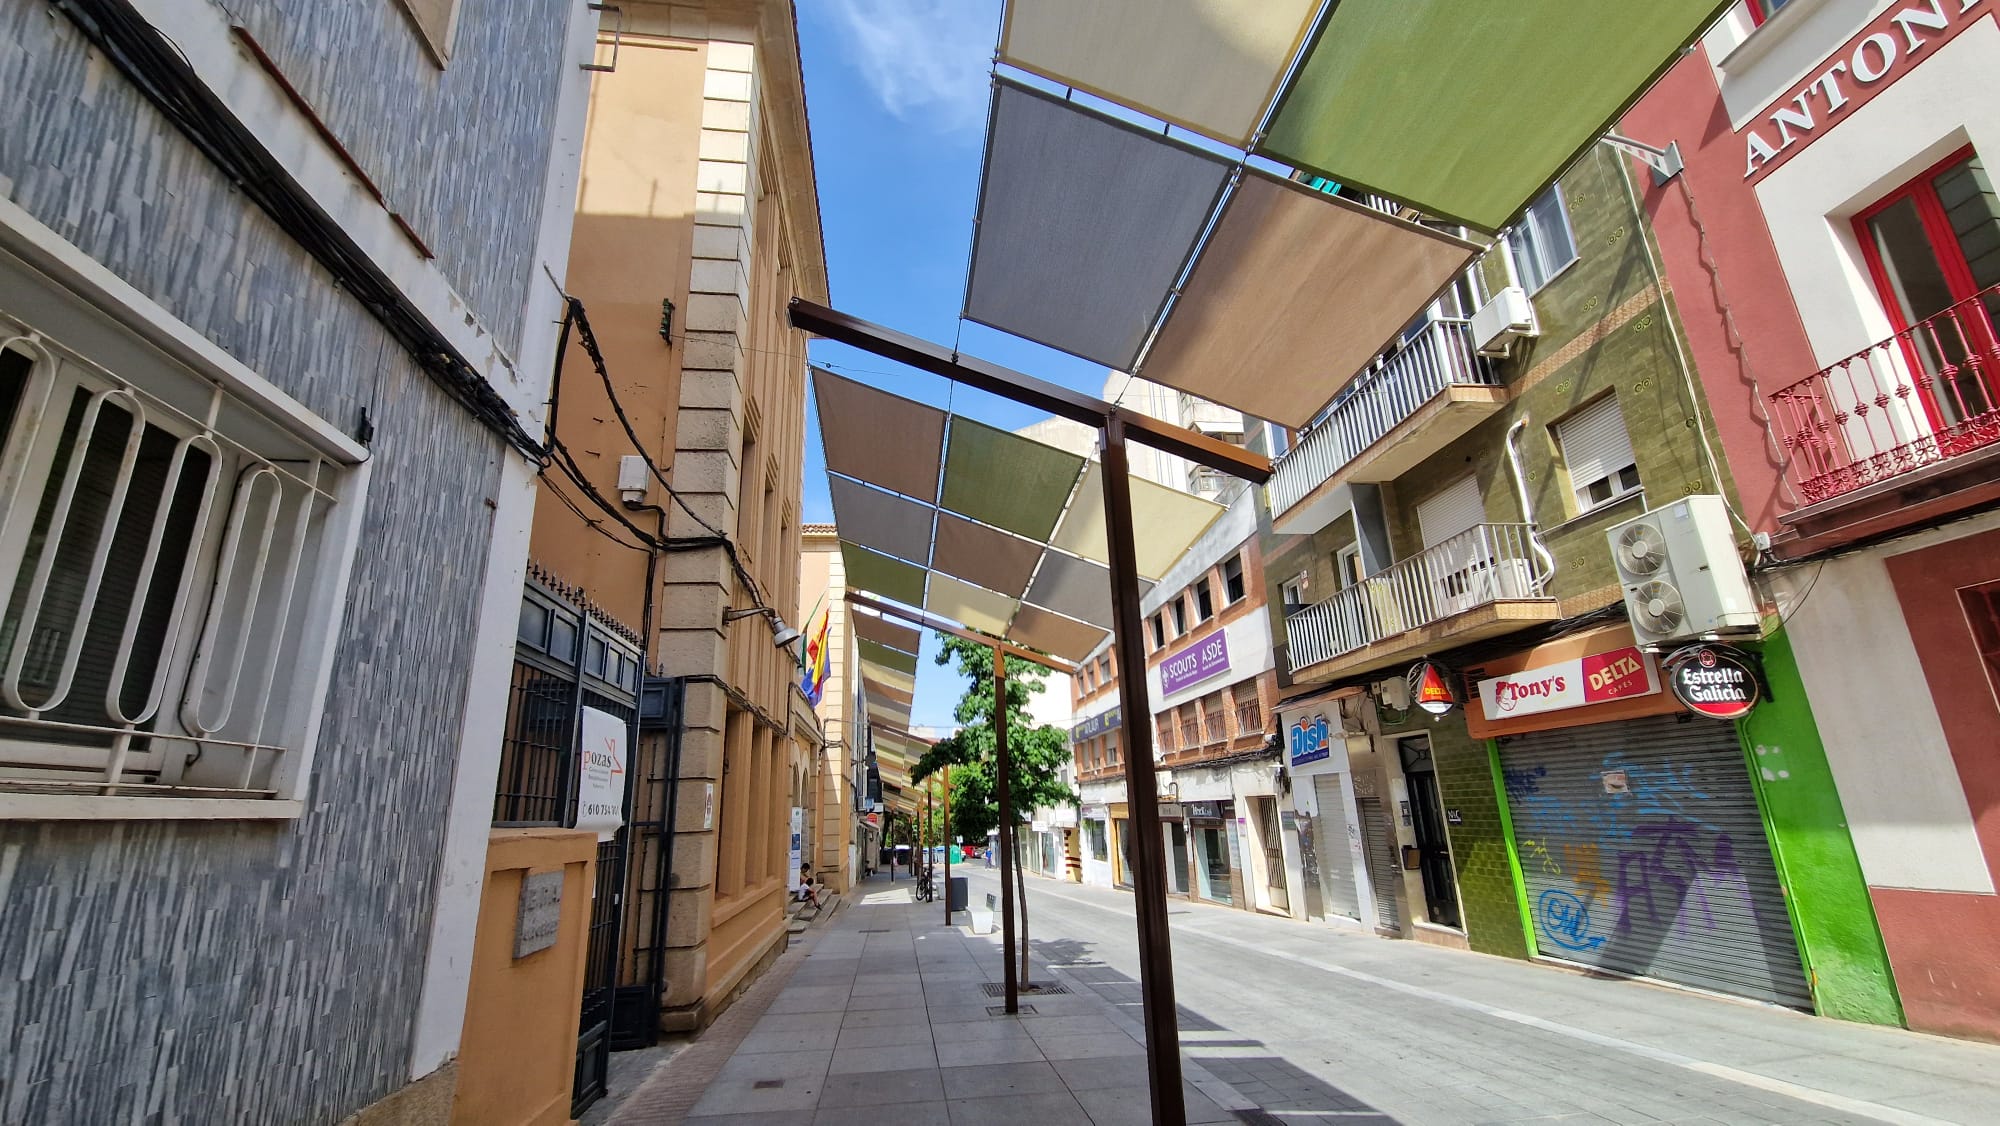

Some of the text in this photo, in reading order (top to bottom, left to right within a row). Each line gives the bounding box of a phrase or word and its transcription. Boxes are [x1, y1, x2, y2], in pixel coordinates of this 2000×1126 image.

[1744, 0, 1980, 178] ANTON
[1169, 653, 1197, 679] SCOUTS
[1202, 639, 1223, 664] ASDE
[1589, 656, 1641, 691] DELTA
[1507, 675, 1566, 701] Tony's
[1683, 667, 1744, 685] Estrella
[1690, 684, 1746, 702] Galicia
[1291, 717, 1328, 758] Dish
[583, 750, 612, 770] pozas
